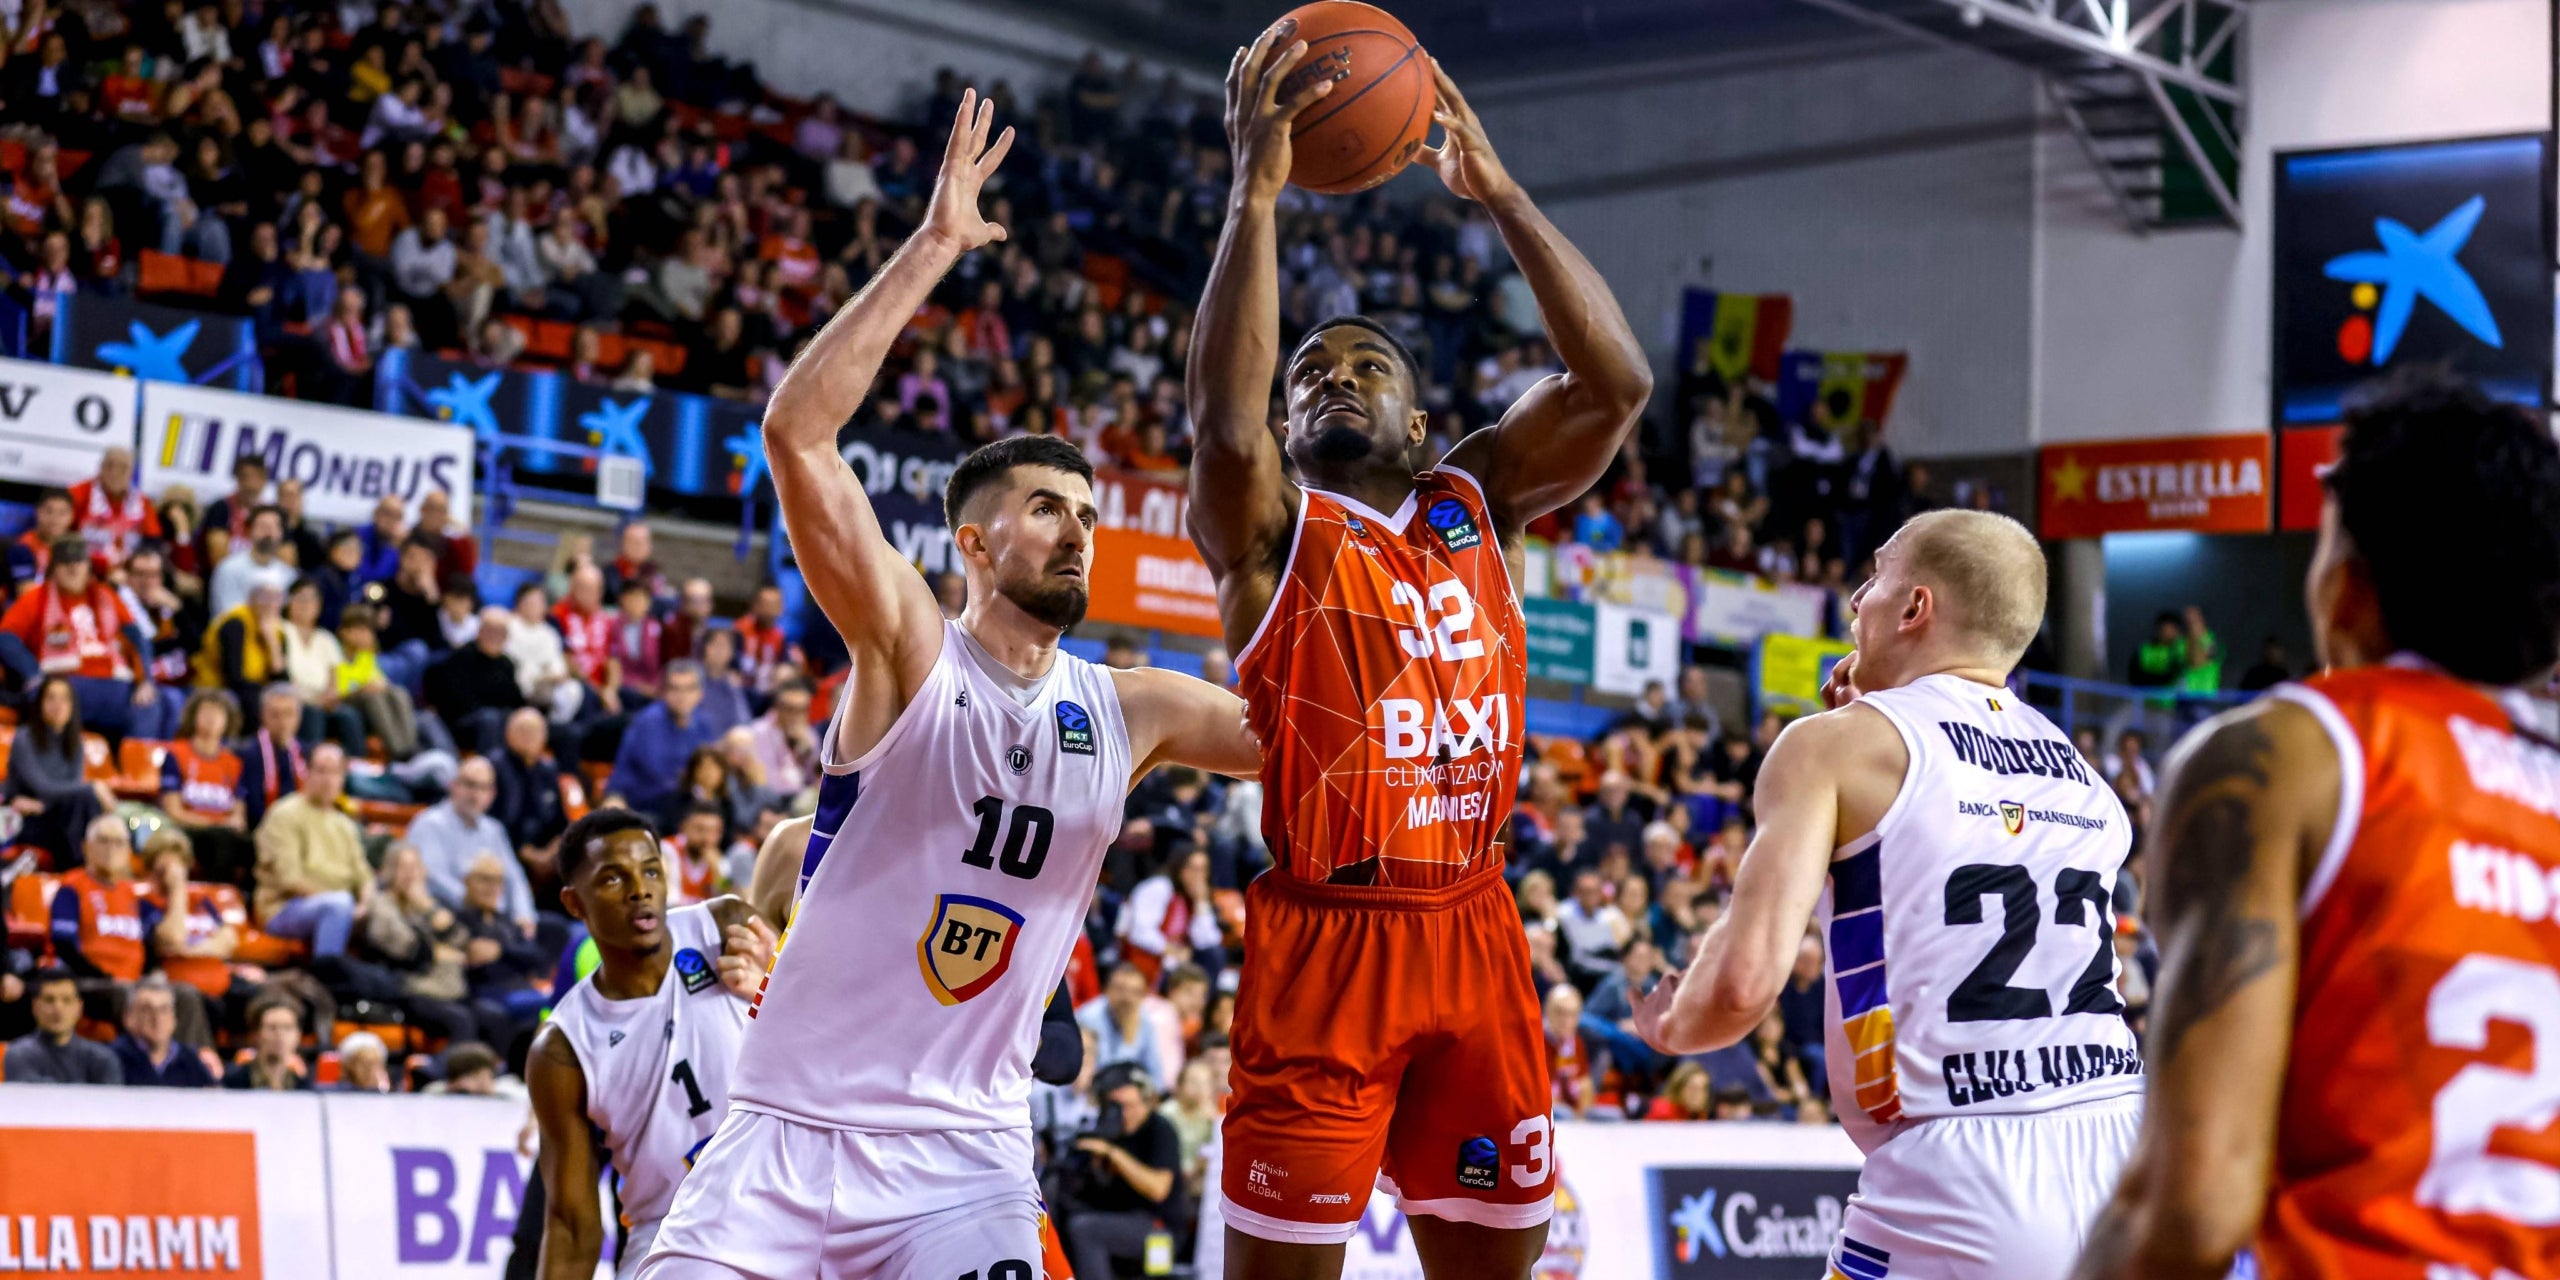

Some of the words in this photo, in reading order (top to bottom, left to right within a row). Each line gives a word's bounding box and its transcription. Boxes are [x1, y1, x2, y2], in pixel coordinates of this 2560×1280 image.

[2096, 458, 2263, 499] ESTRELLA
[1448, 534, 1479, 549] EuroCup
[1390, 578, 1486, 662] 32
[1063, 740, 1093, 752] EuroCup
[1380, 693, 1509, 758] BAXI
[1938, 722, 2092, 787] WOODBURY
[1959, 800, 1998, 817] BANCA
[962, 794, 1056, 880] 10
[941, 918, 1002, 963] BT
[1944, 863, 2127, 1023] 22
[671, 1058, 712, 1119] 1
[1510, 1110, 1555, 1188] 3
[1247, 1181, 1284, 1201] GLOBAL
[1249, 1169, 1269, 1186] ETL
[1459, 1175, 1494, 1188] EuroCup
[0, 1214, 82, 1271] LLA
[88, 1214, 241, 1271] DAMM
